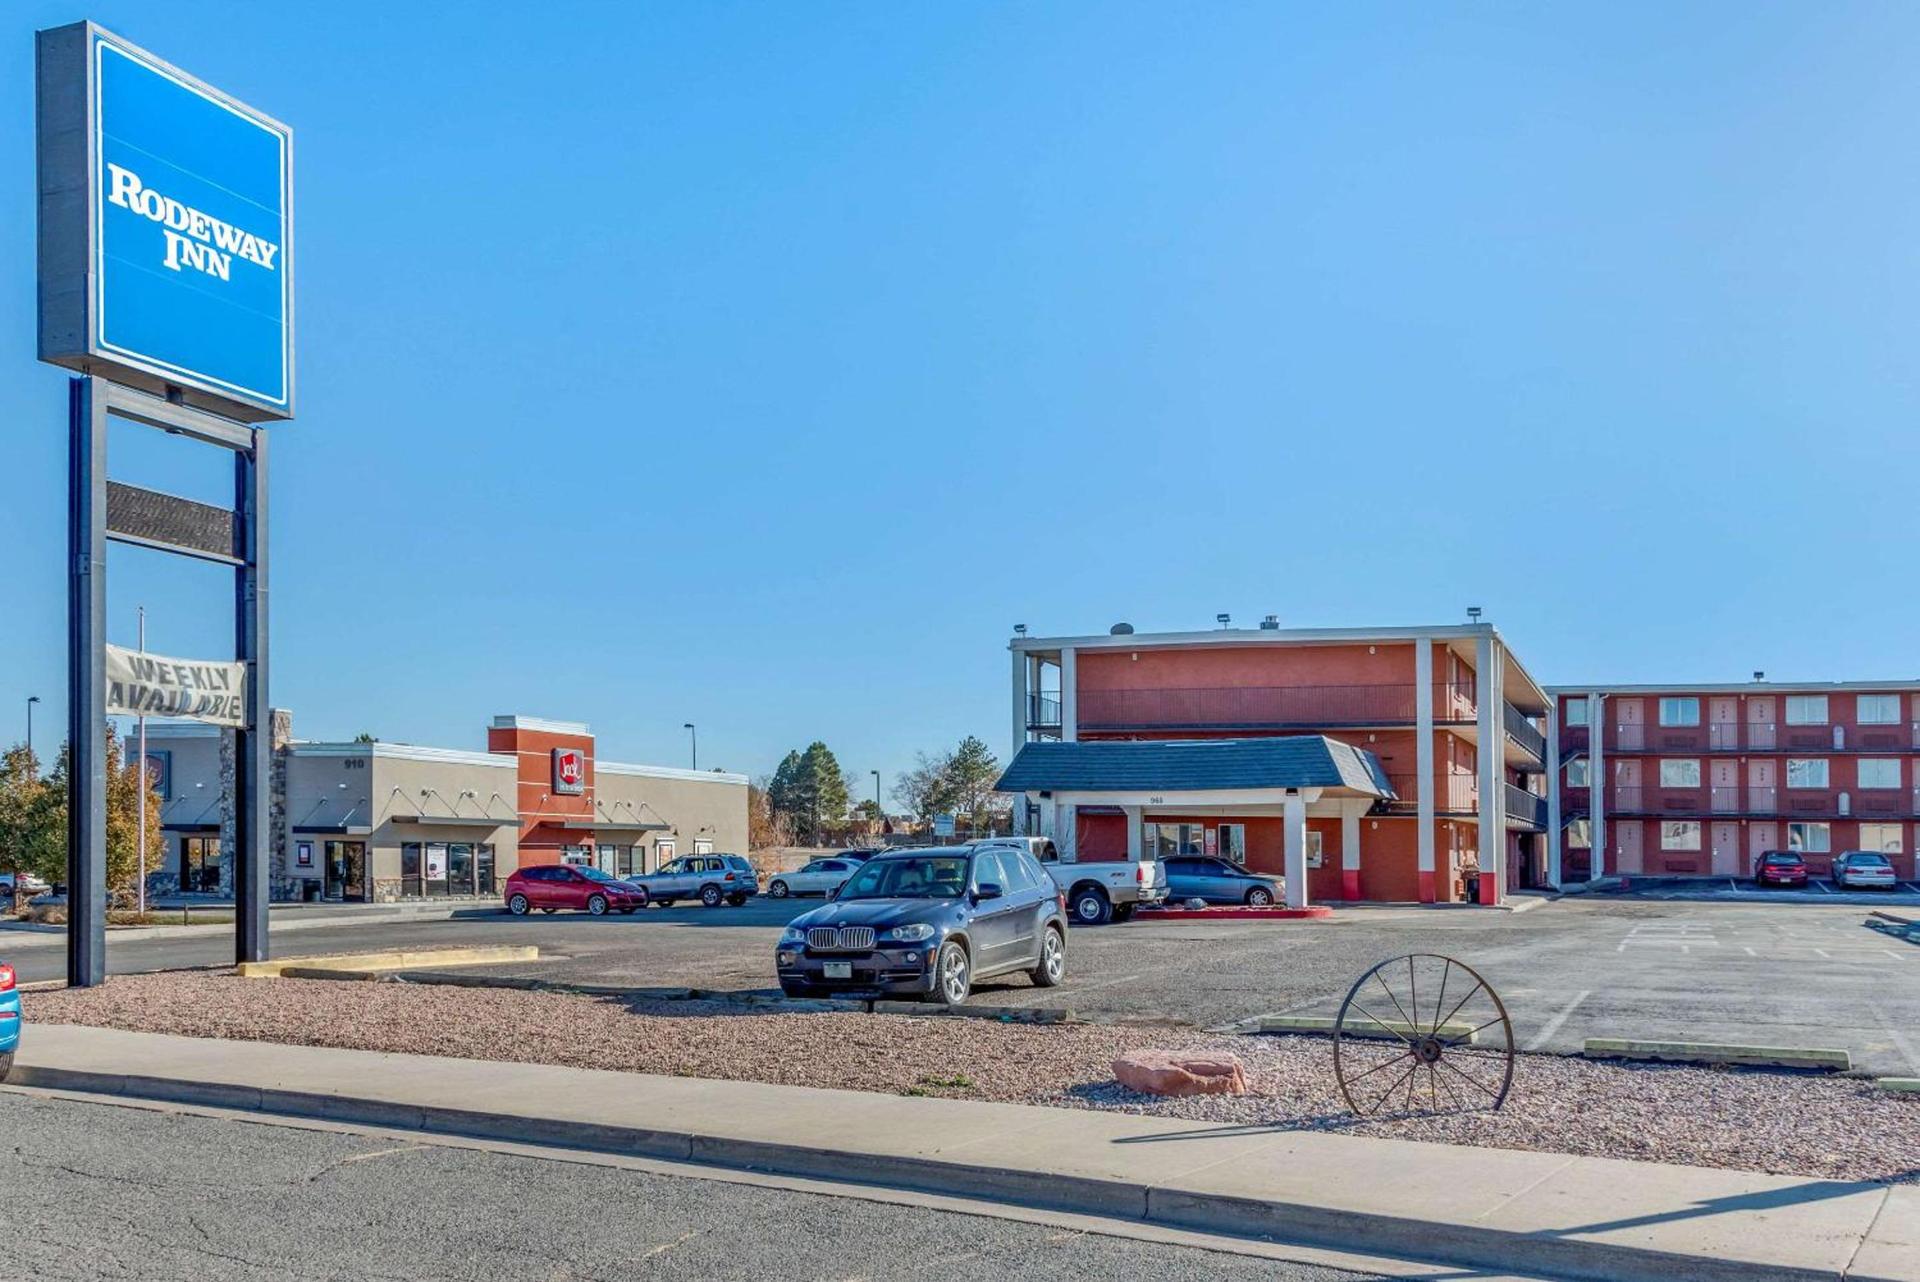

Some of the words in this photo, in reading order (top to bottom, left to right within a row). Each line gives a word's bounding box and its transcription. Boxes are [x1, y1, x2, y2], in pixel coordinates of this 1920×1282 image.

[107, 162, 278, 271] RODEWAY
[163, 229, 232, 282] INN
[128, 656, 229, 690] WEEKLY
[344, 758, 364, 769] 910
